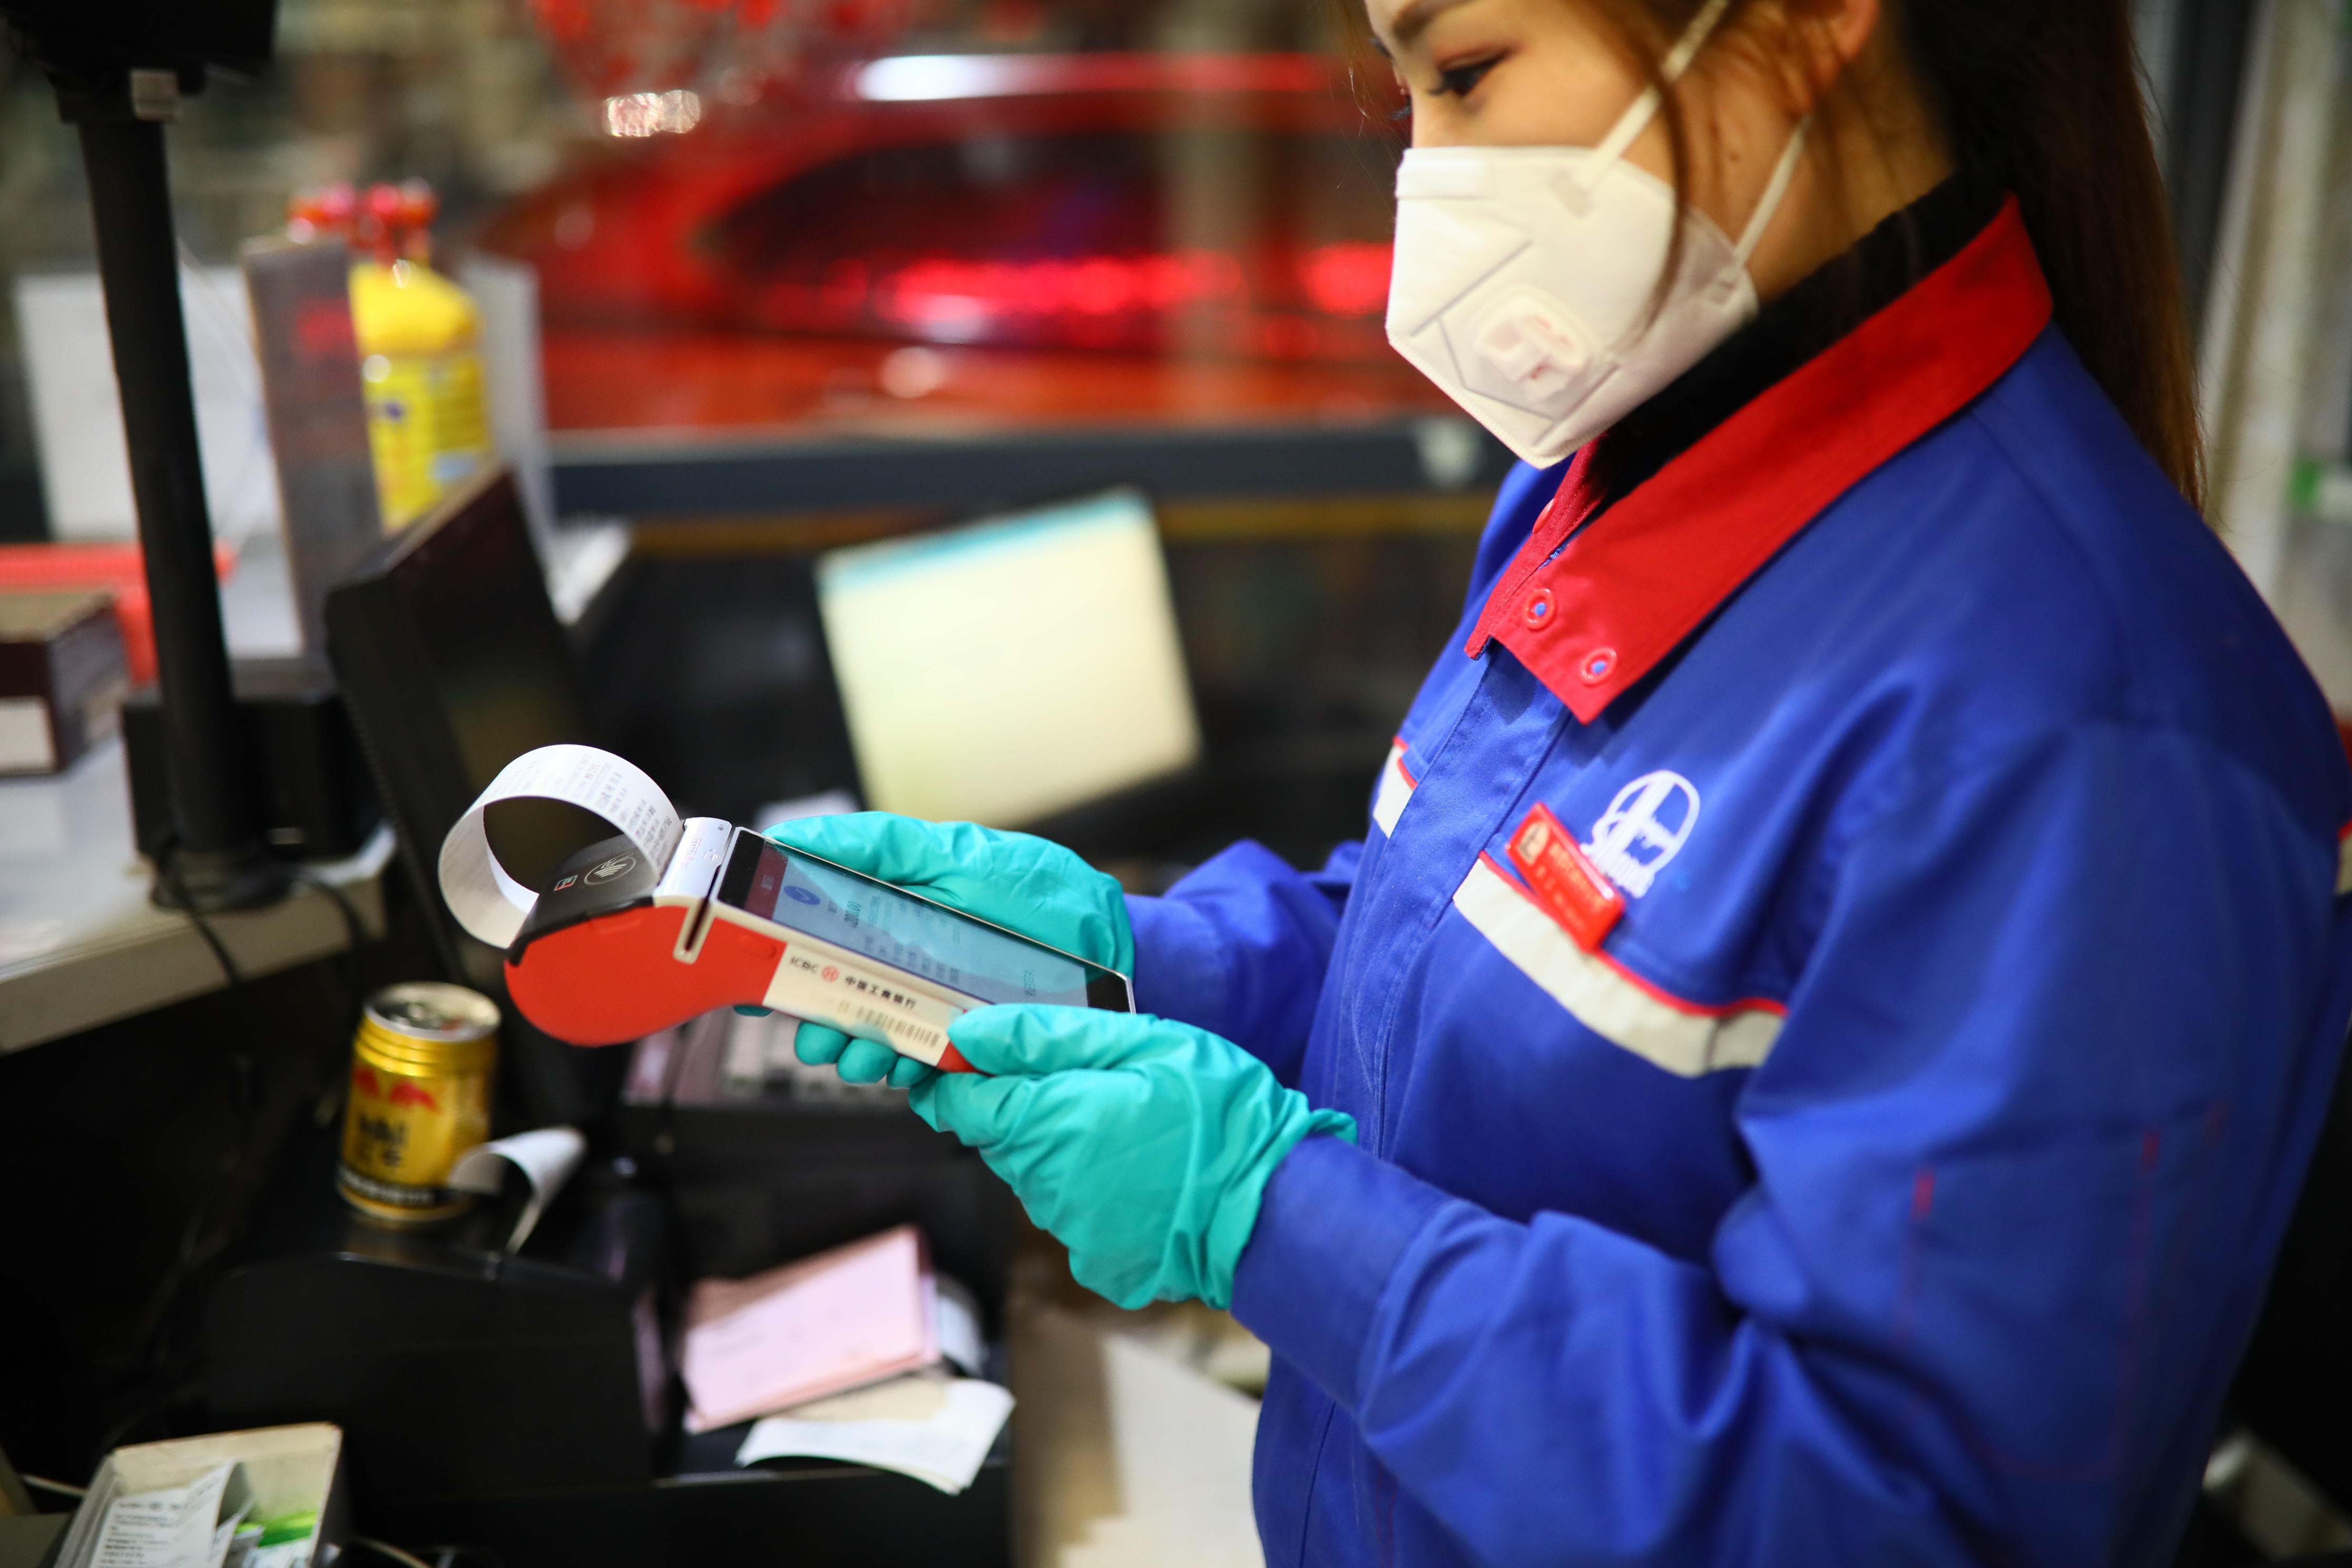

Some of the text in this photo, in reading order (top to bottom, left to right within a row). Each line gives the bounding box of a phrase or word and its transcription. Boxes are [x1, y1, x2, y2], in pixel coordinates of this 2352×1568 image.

[790, 956, 916, 1010] ICBC 中国工商银行
